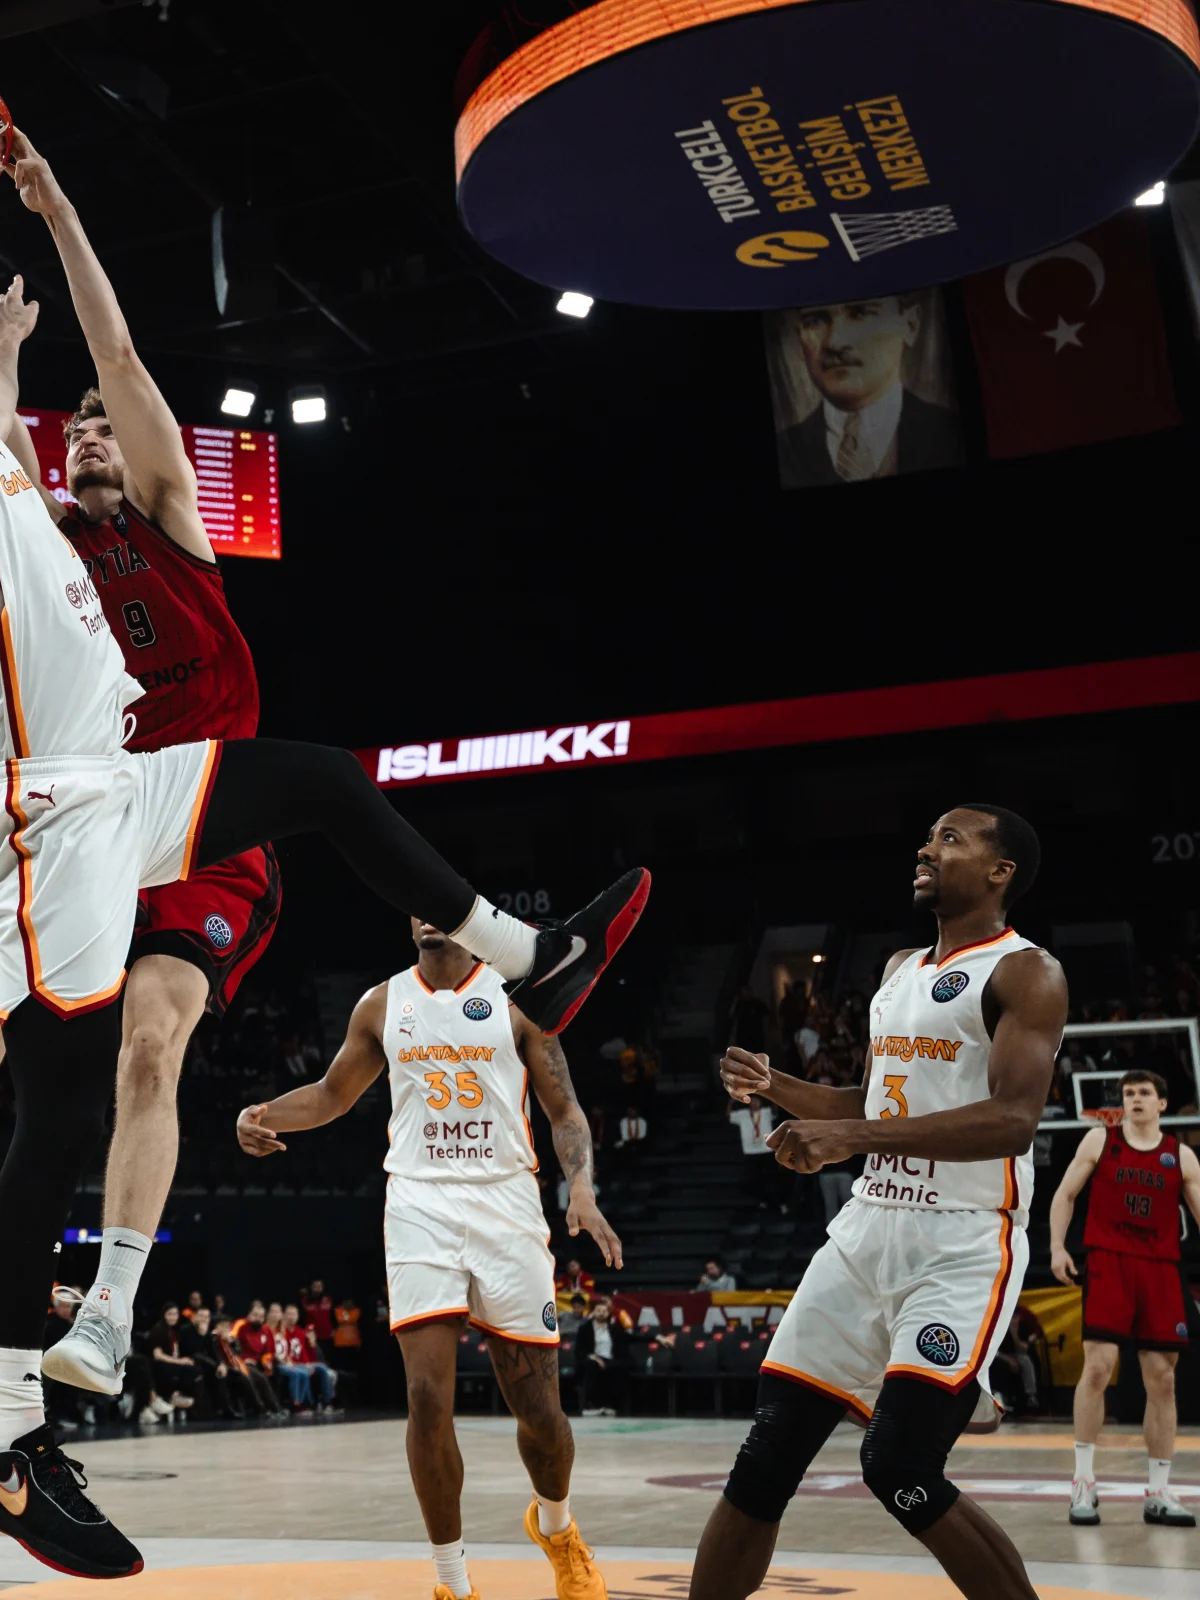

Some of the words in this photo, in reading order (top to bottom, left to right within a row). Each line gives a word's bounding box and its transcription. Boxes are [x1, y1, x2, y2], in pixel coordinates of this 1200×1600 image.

[722, 86, 817, 213] BASKETBOL
[674, 120, 760, 223] TURKCELL
[122, 600, 156, 648] 9
[498, 889, 551, 917] 208
[398, 1046, 496, 1064] GALATASARAY
[872, 1036, 963, 1063] ALATASARAY
[424, 1071, 484, 1110] 35
[879, 1075, 908, 1120] 3
[443, 1121, 493, 1140] MCT
[426, 1144, 494, 1160] Technic
[860, 1175, 939, 1205] Technic
[1124, 1192, 1152, 1218] 43
